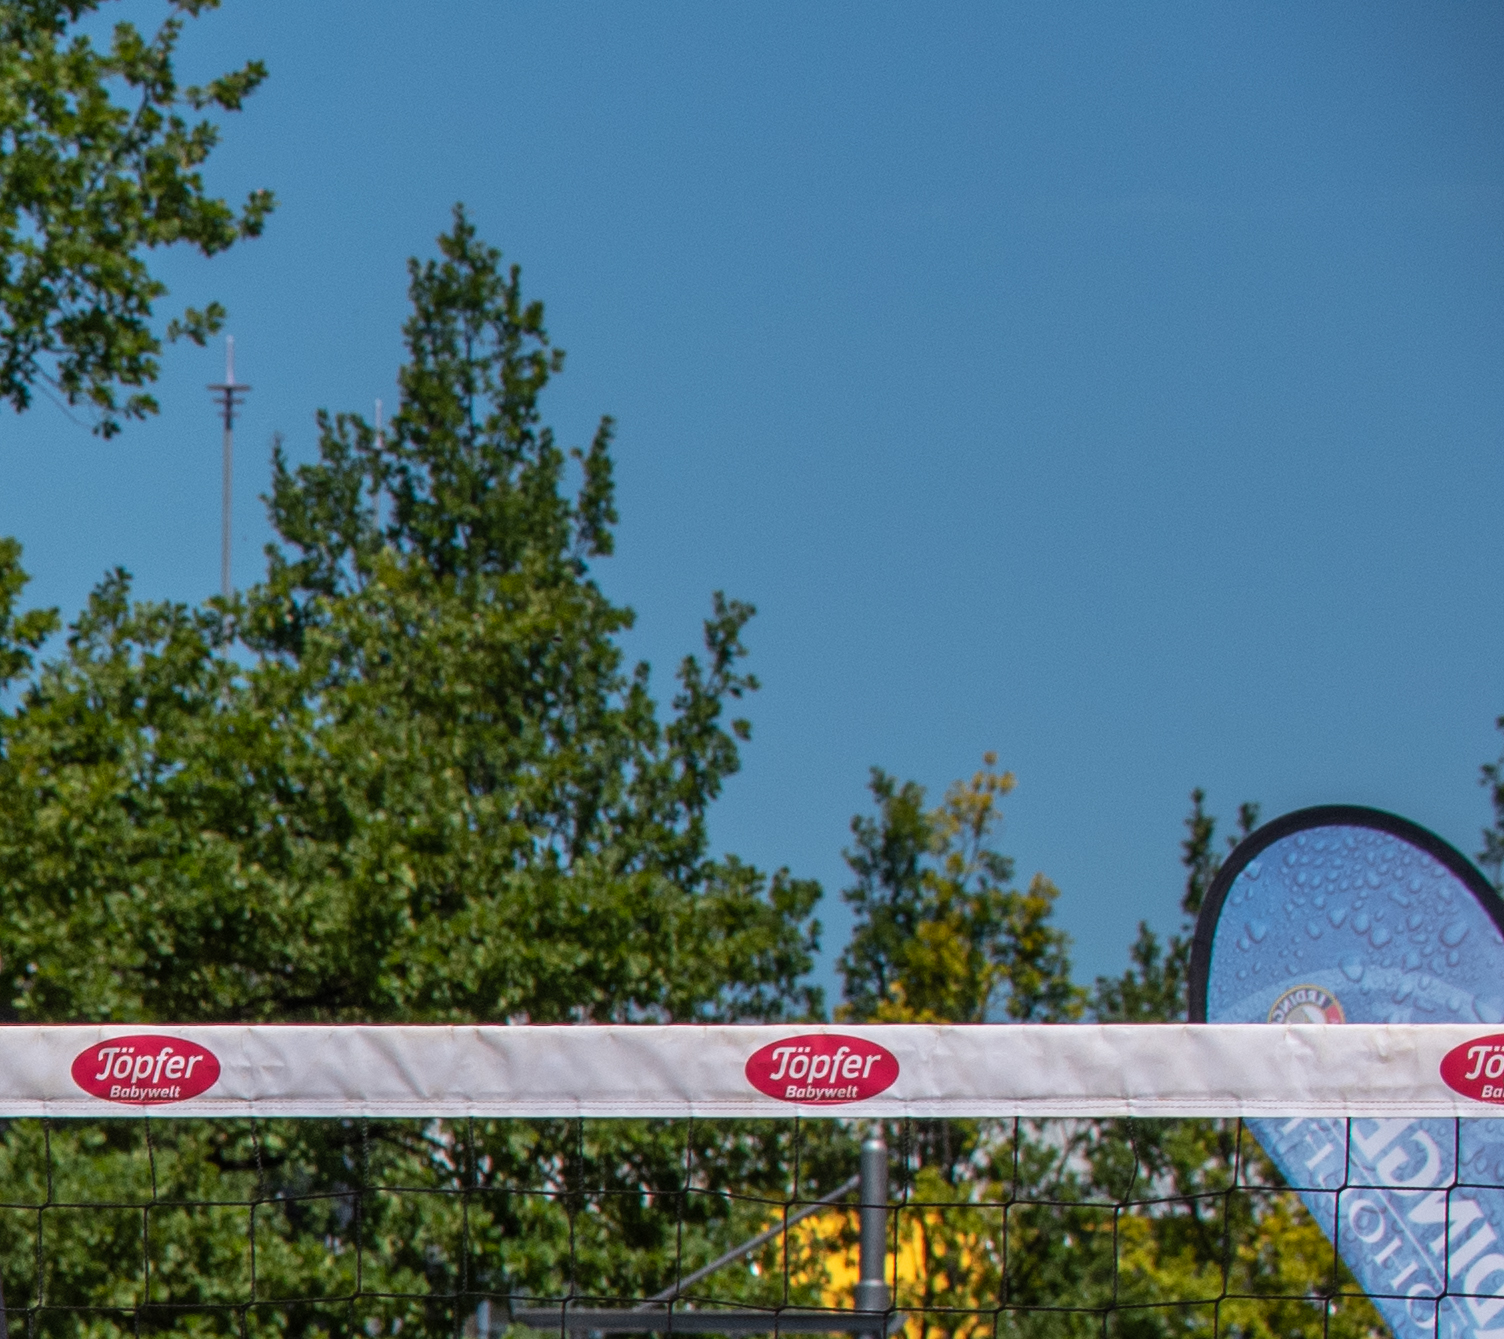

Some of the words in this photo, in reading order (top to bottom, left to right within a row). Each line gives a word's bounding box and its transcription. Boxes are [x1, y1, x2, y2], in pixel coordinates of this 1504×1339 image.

[95, 1046, 204, 1084] Töpfer
[769, 1046, 881, 1084] Töpfer
[110, 1085, 181, 1100] Babywelt
[785, 1085, 858, 1099] Babywelt
